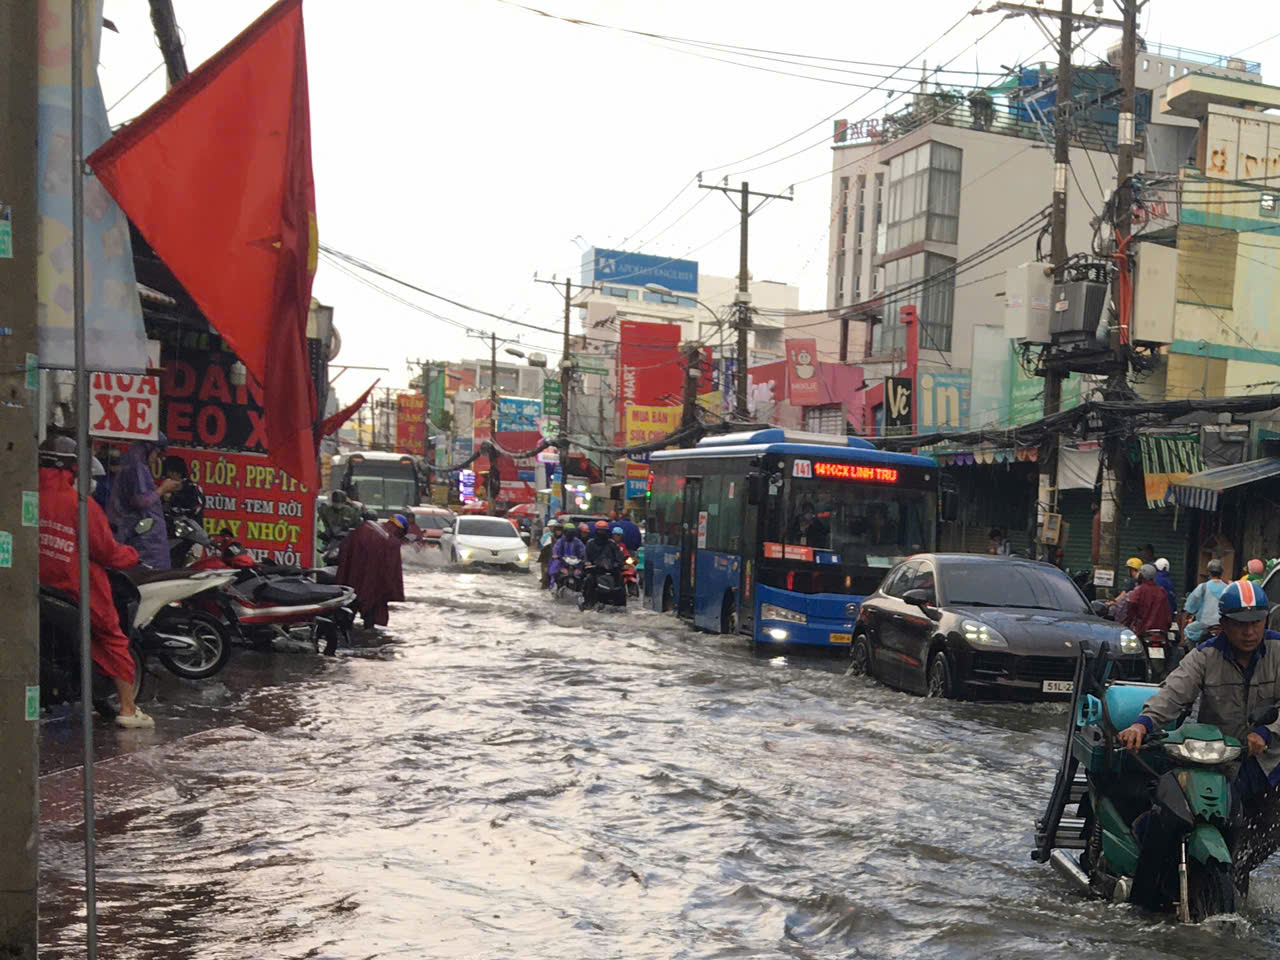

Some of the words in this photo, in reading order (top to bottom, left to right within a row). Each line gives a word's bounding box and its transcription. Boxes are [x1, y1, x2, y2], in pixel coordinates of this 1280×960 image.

[93, 394, 153, 435] XE
[921, 374, 959, 427] in
[1047, 682, 1073, 691] 51L-2
